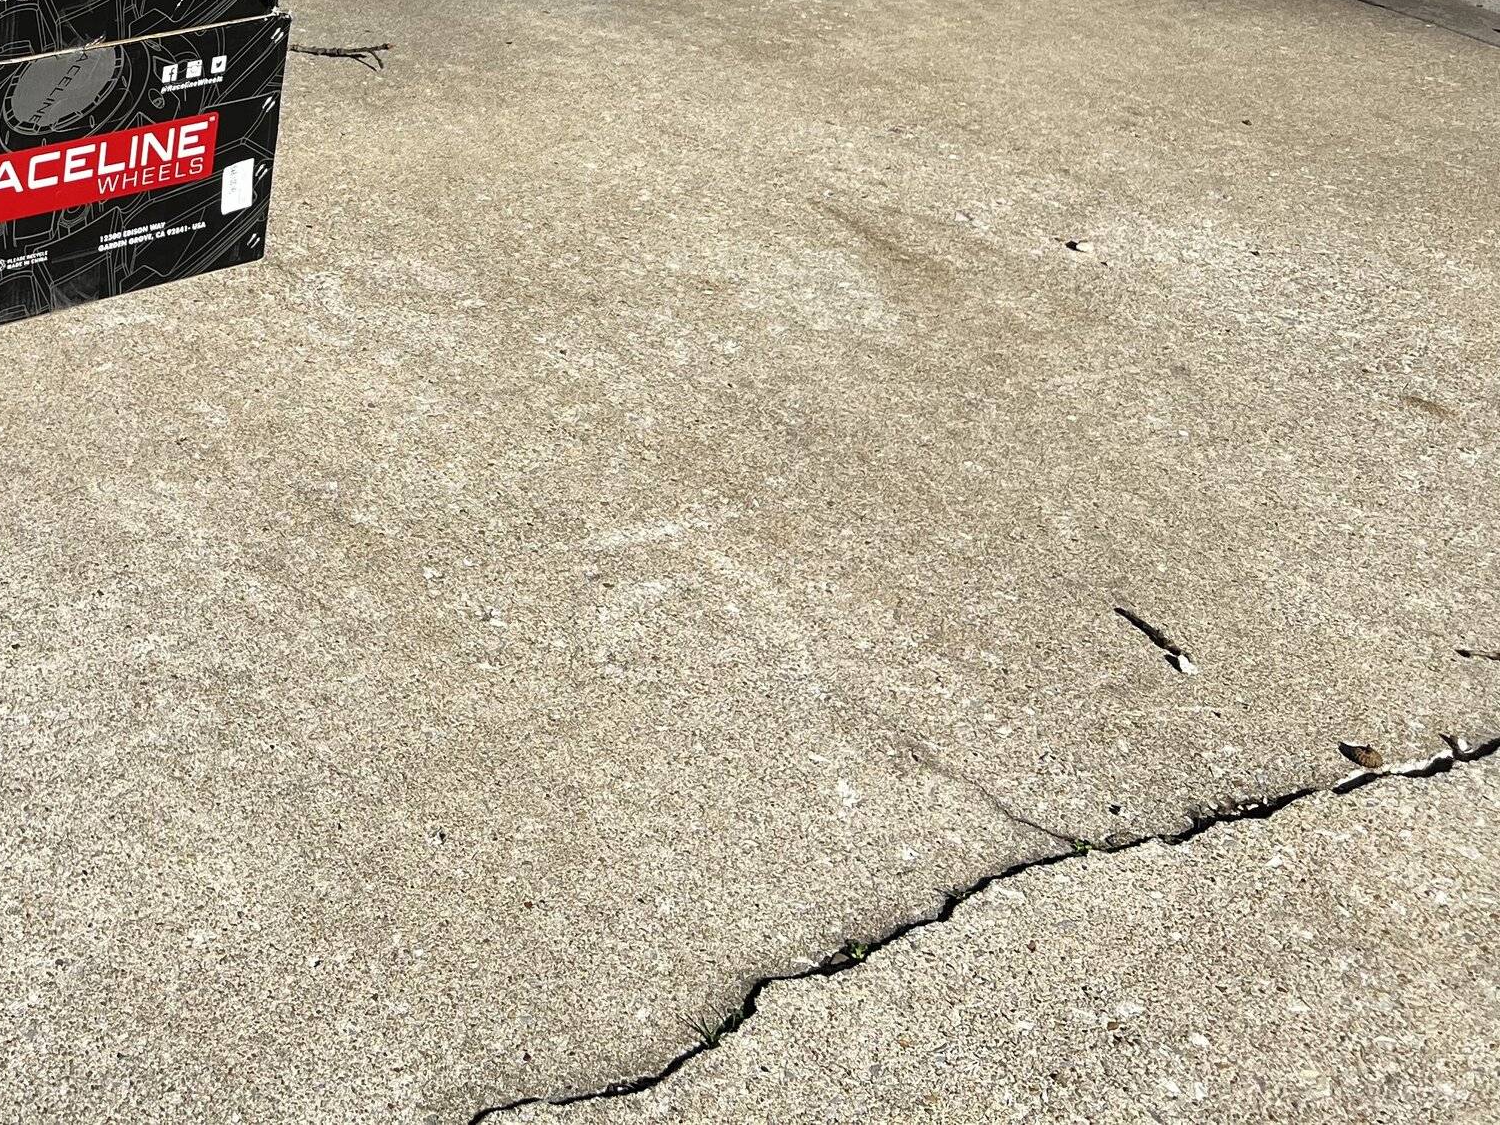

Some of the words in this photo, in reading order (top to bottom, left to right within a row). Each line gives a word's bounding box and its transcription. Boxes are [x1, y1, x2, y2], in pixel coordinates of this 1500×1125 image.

[29, 52, 89, 124] ACELINE
[97, 156, 205, 195] WHEELS
[155, 230, 166, 239] CA
